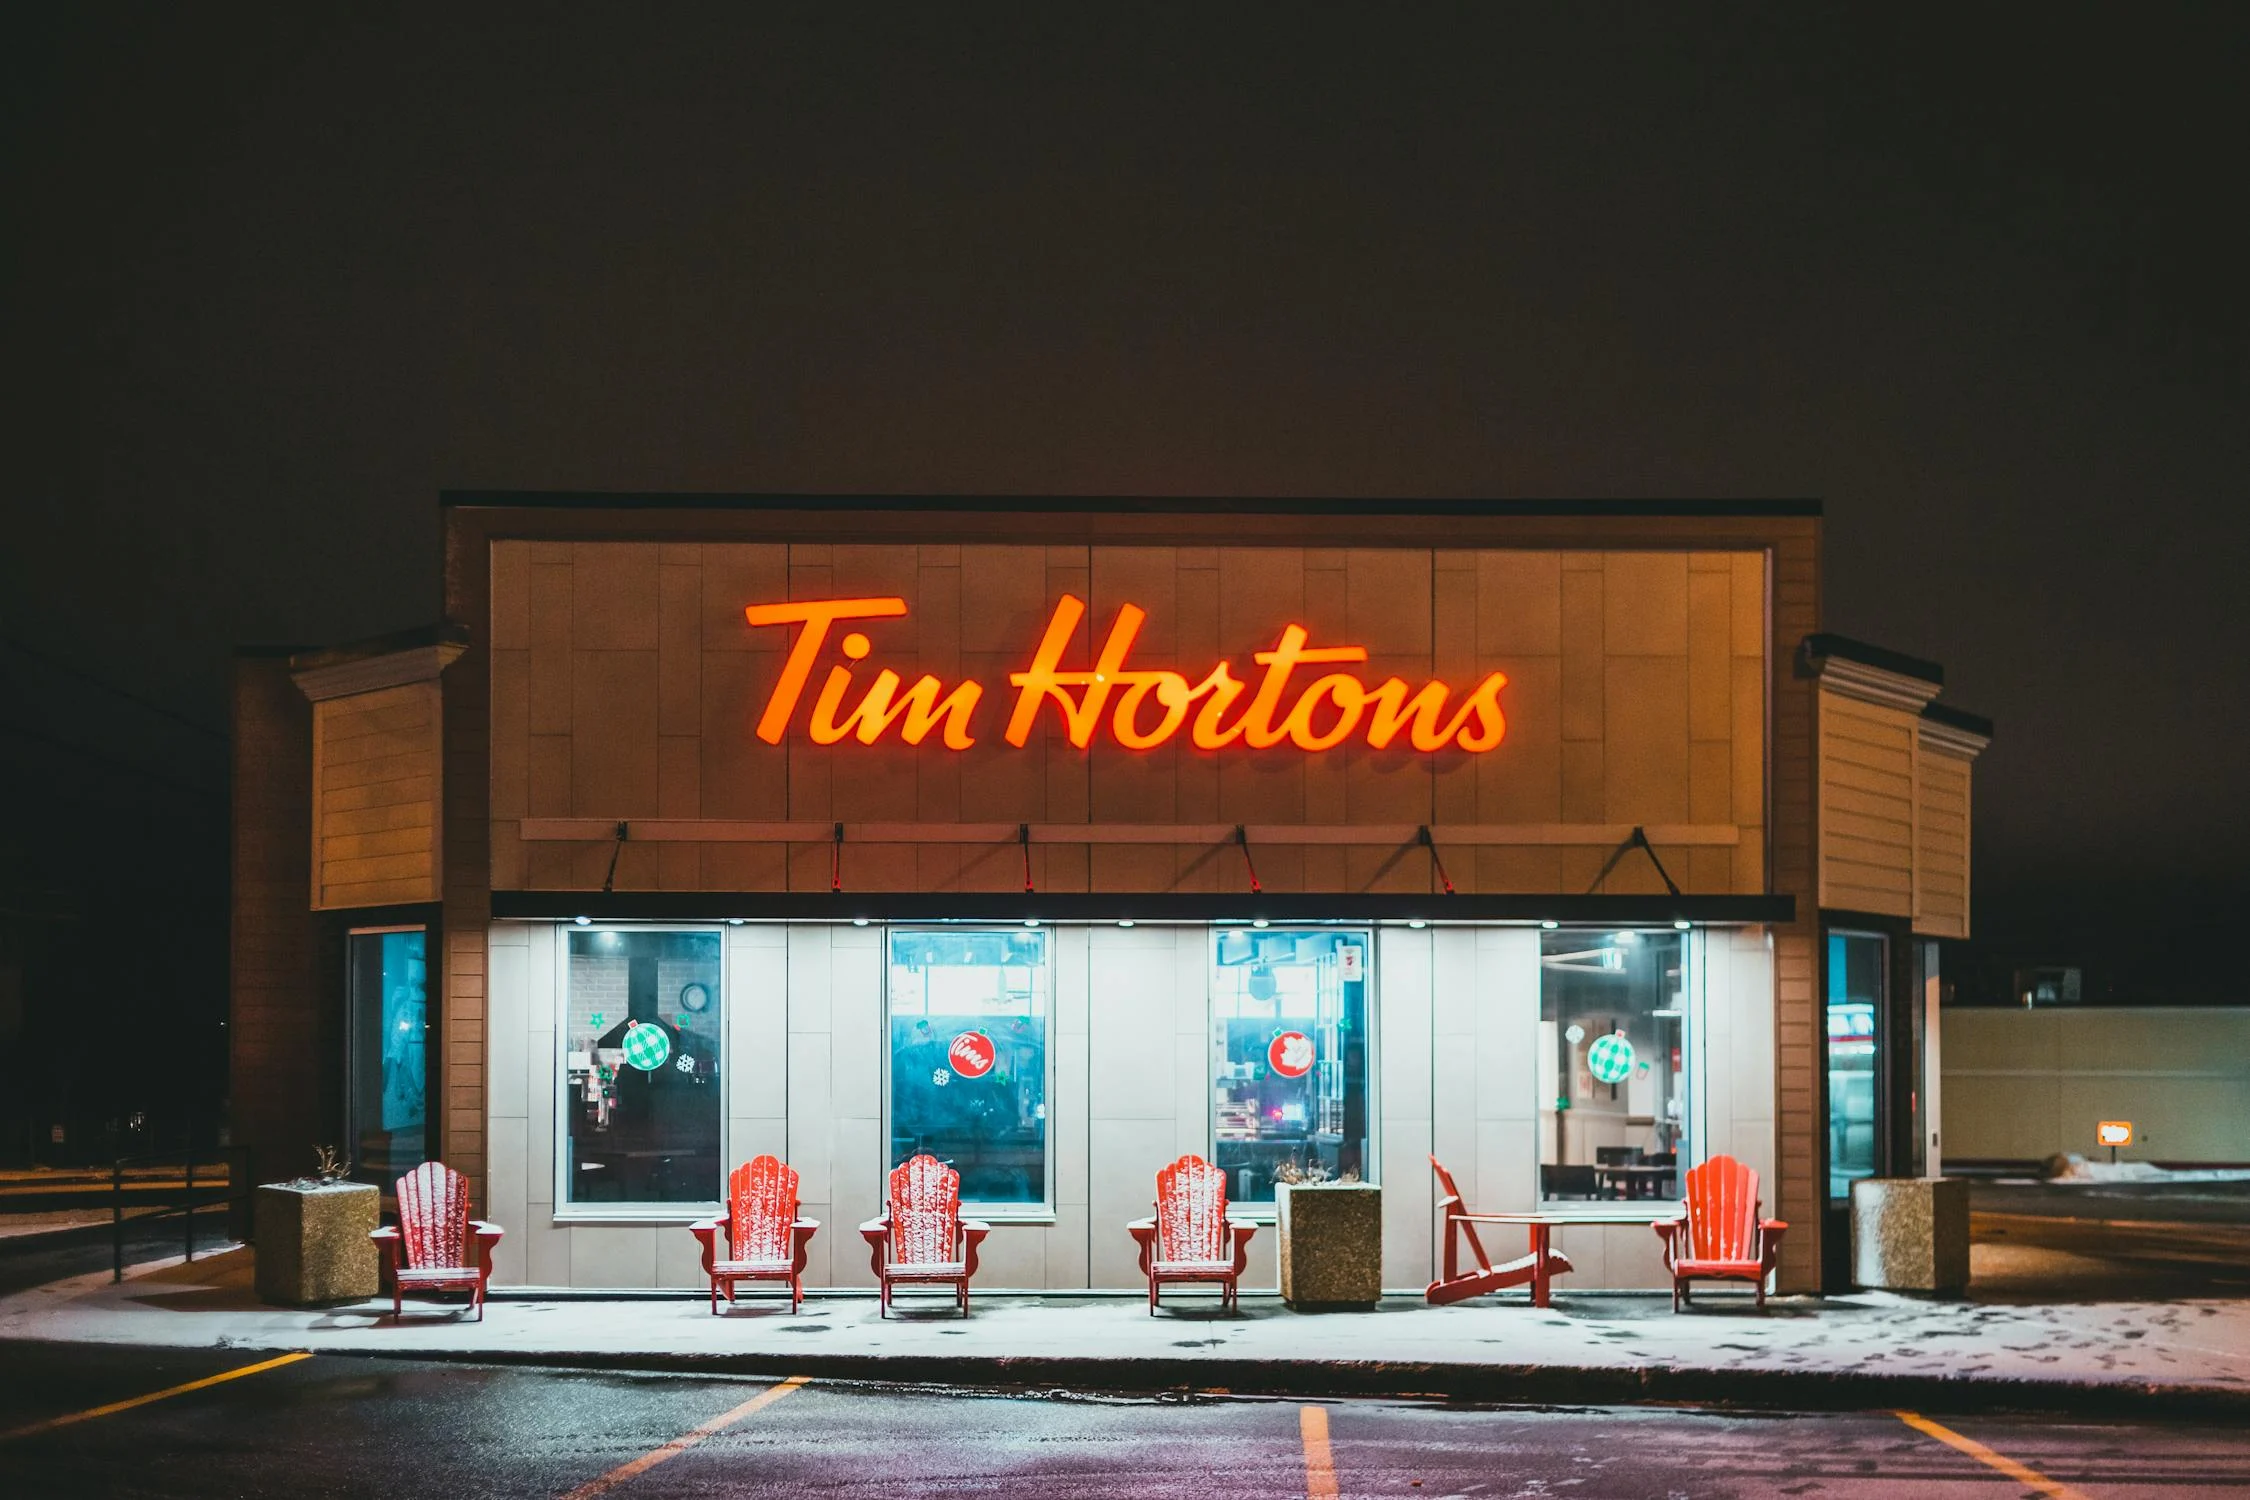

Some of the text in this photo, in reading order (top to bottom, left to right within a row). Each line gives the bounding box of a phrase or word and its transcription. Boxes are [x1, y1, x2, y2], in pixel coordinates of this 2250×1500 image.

[745, 594, 1508, 752] Tim Hortons
[951, 1034, 989, 1069] Tims
